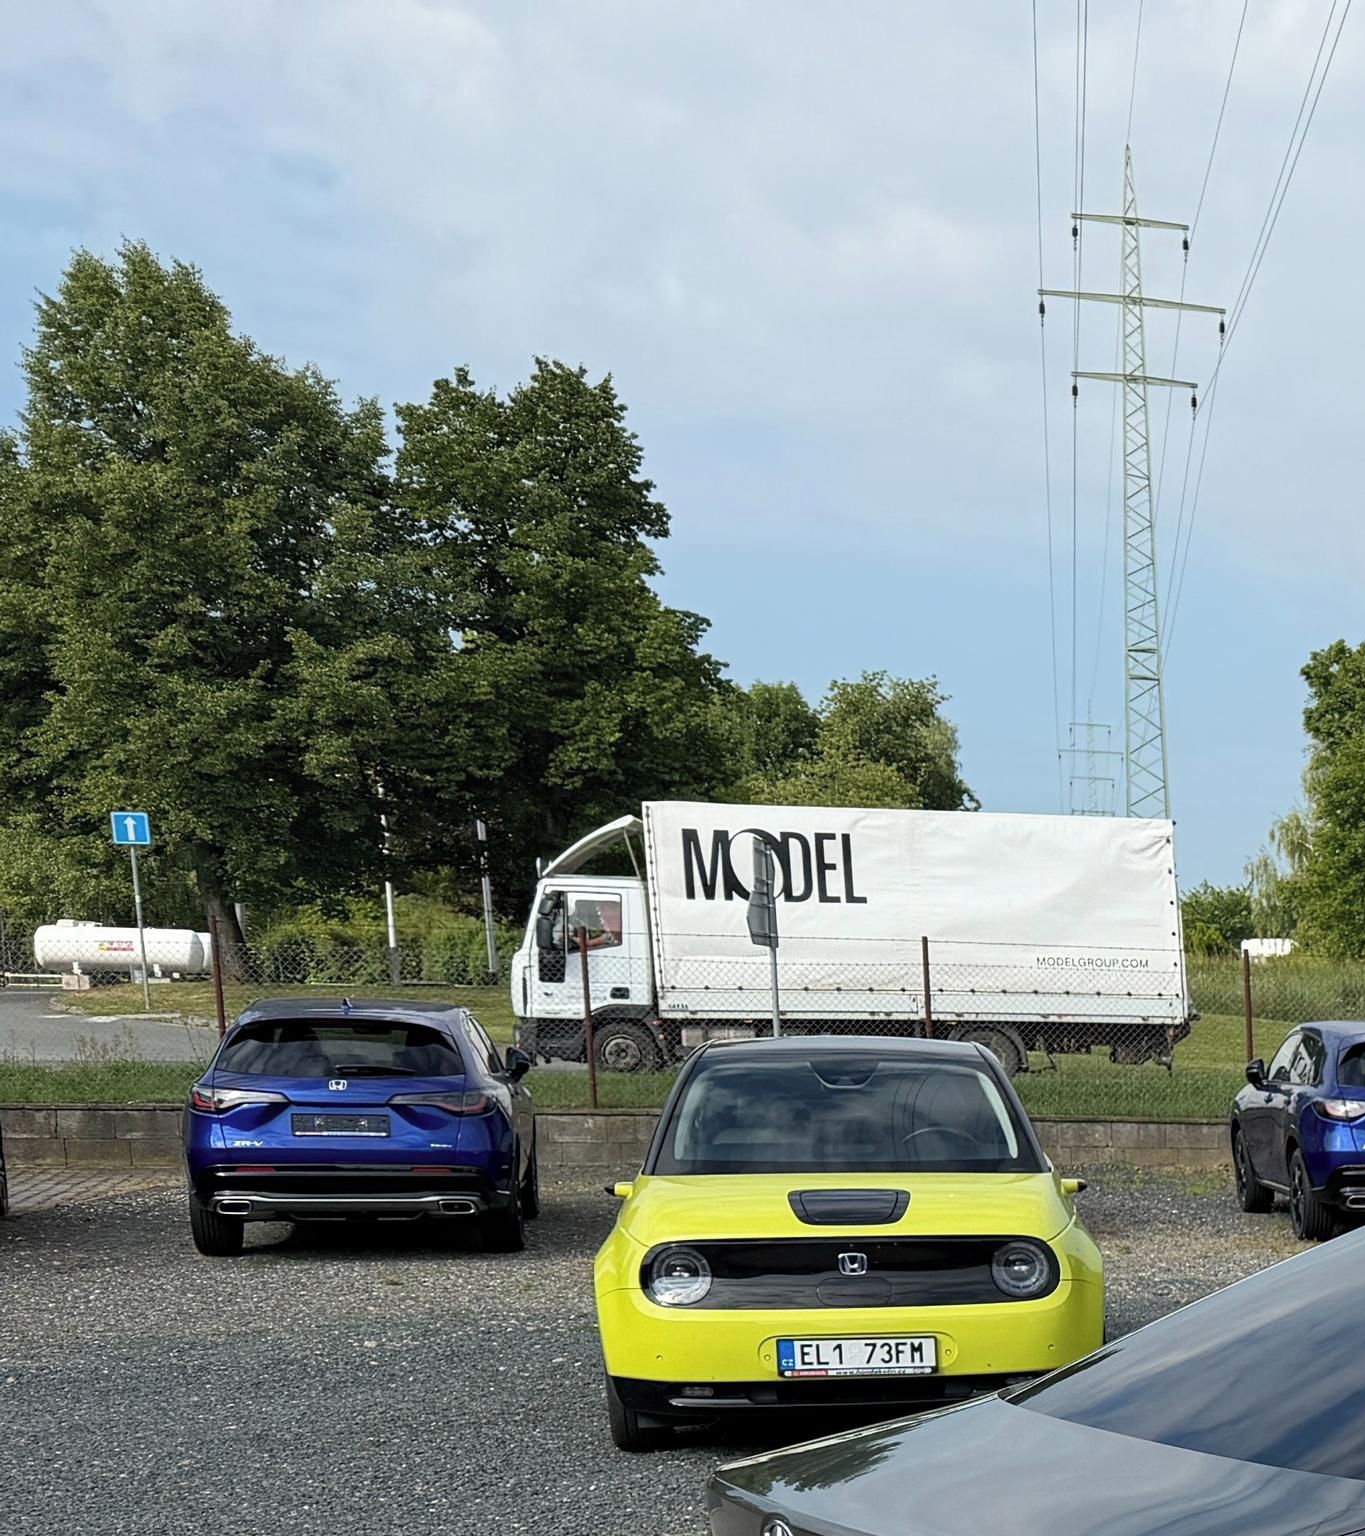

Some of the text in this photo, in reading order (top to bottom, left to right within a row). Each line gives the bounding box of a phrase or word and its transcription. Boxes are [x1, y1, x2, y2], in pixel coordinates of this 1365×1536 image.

[681, 828, 867, 904] MODEL
[1036, 956, 1149, 969] MODELGROUP.COM
[781, 1340, 924, 1367] CZ EL1 73FM
